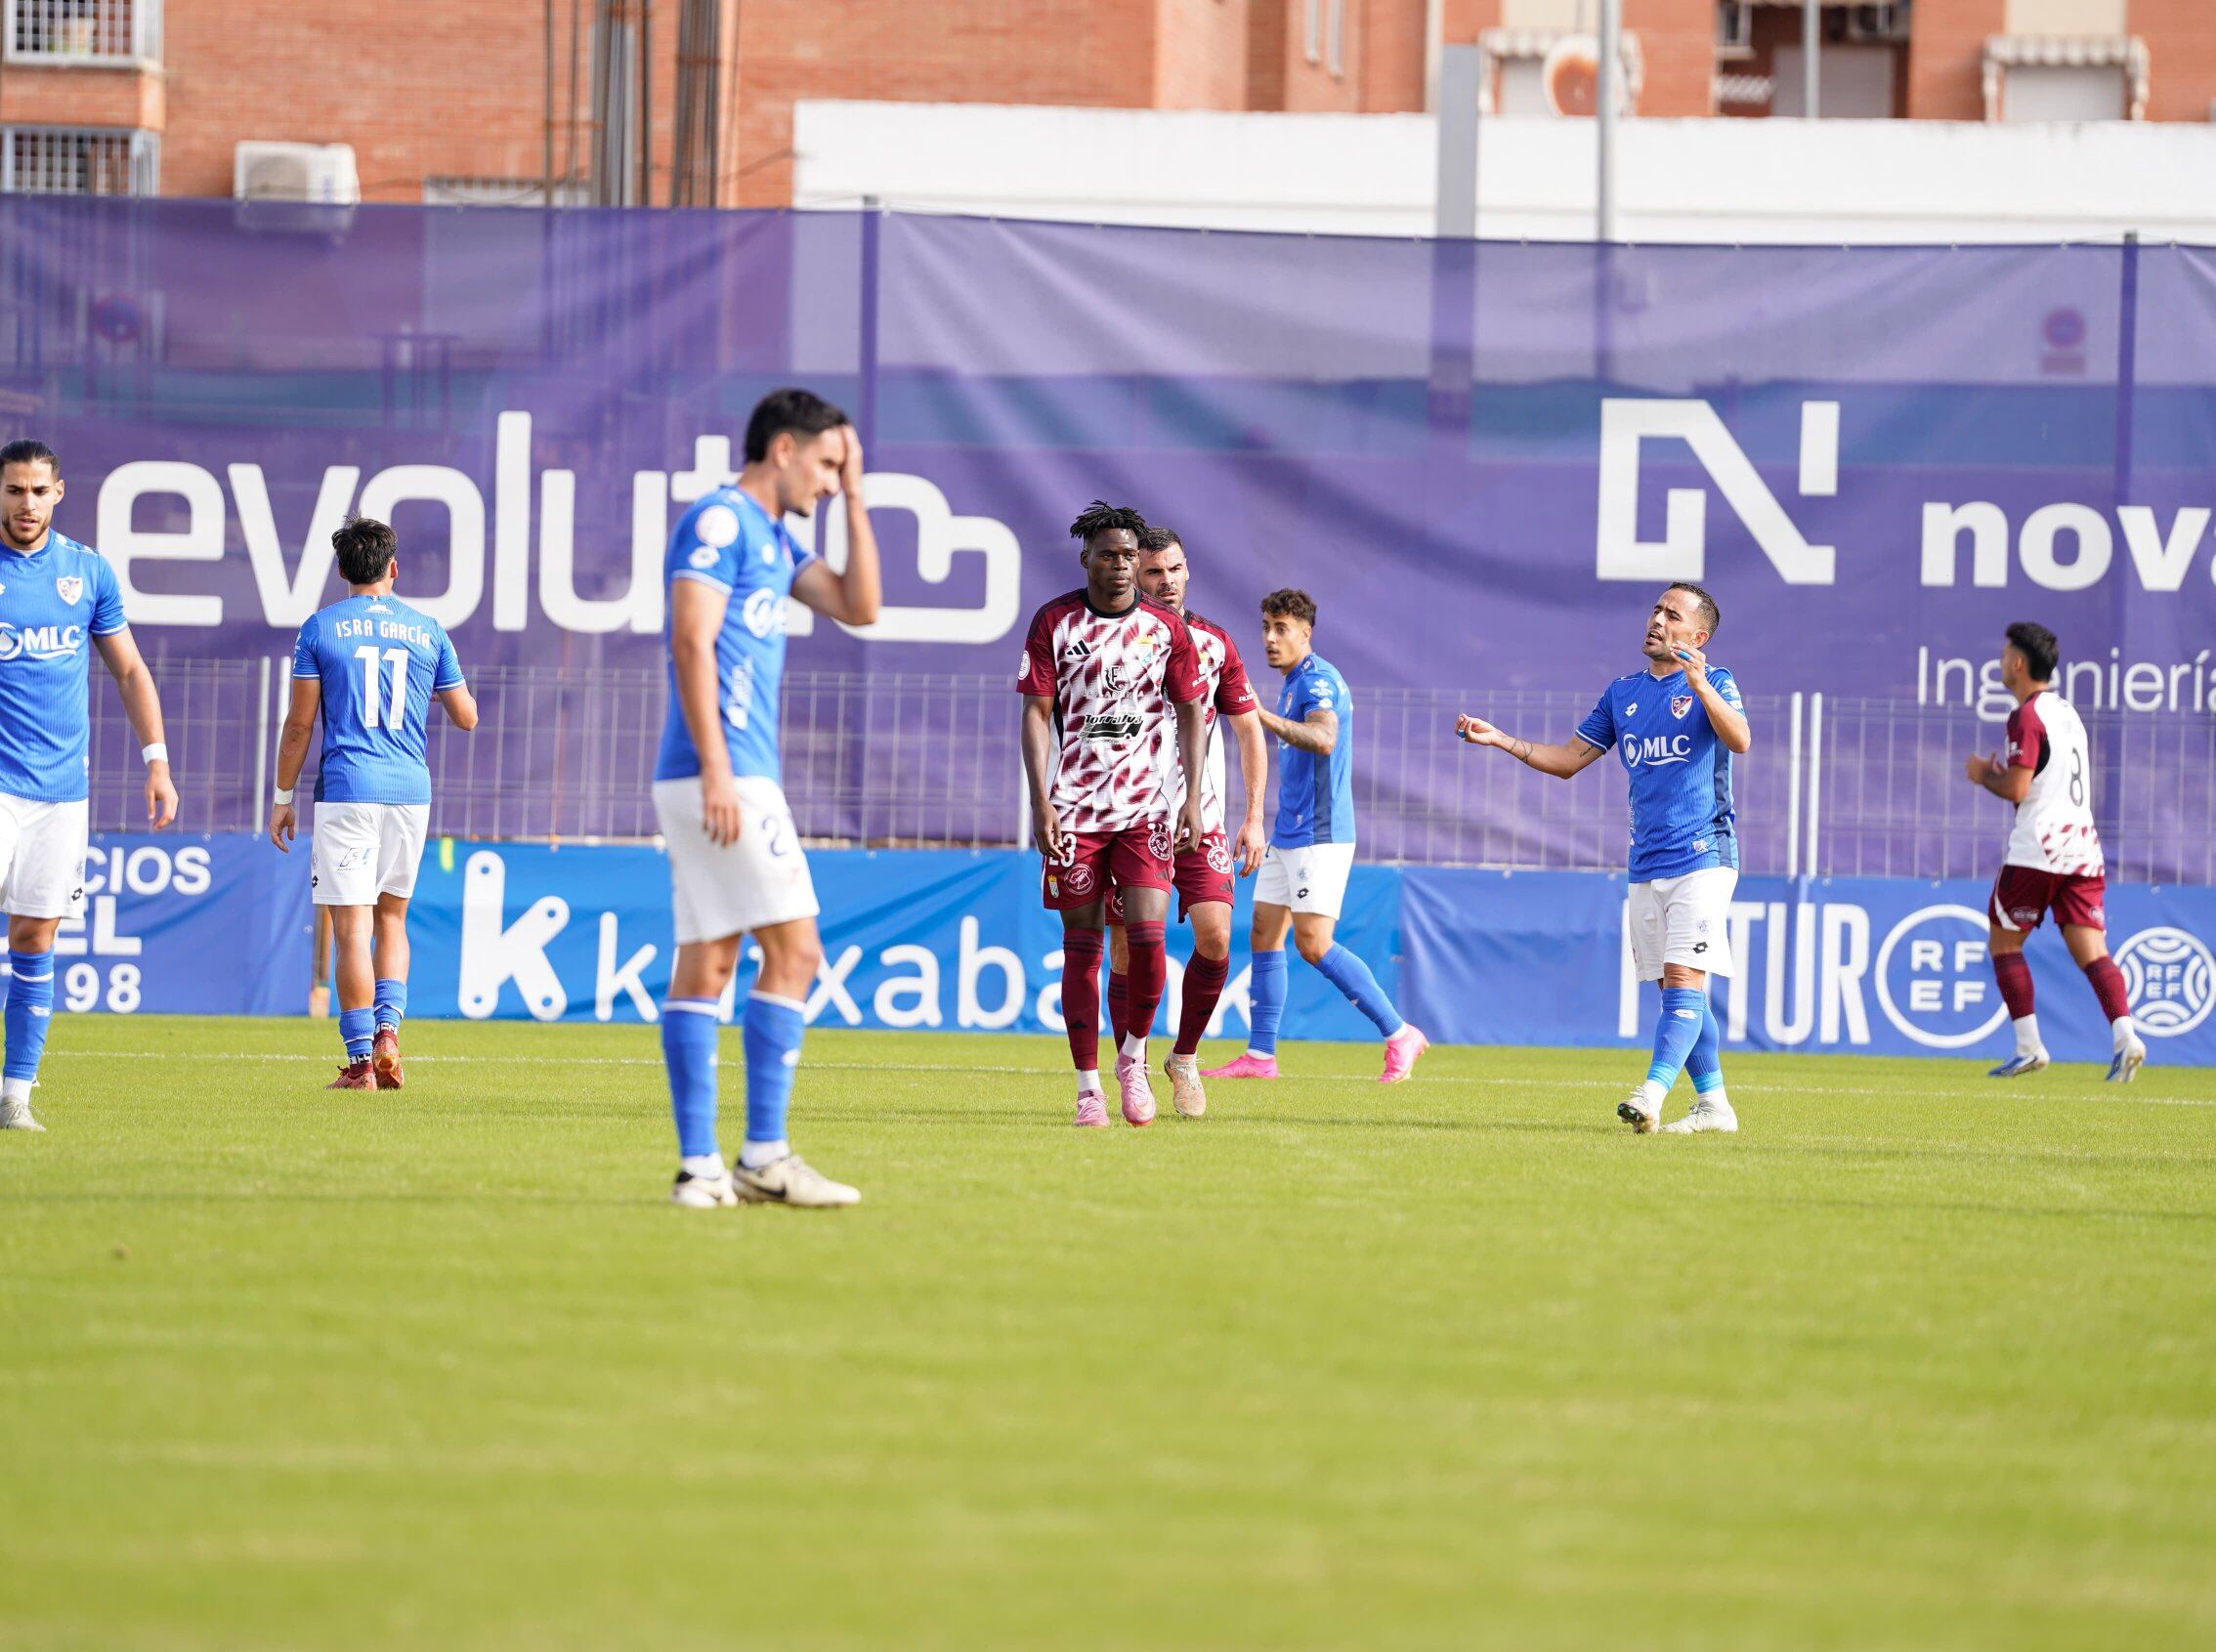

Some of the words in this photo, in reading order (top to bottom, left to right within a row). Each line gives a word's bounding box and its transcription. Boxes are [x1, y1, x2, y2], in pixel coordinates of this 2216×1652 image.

[1921, 500, 2216, 592] nov
[24, 625, 80, 652] MLC
[336, 619, 373, 638] ISRA
[380, 620, 431, 650] GARCÍA
[354, 645, 408, 730] 11
[1917, 646, 2216, 722] Ingnierí
[1643, 735, 1691, 759] MLC
[2069, 745, 2084, 807] 8
